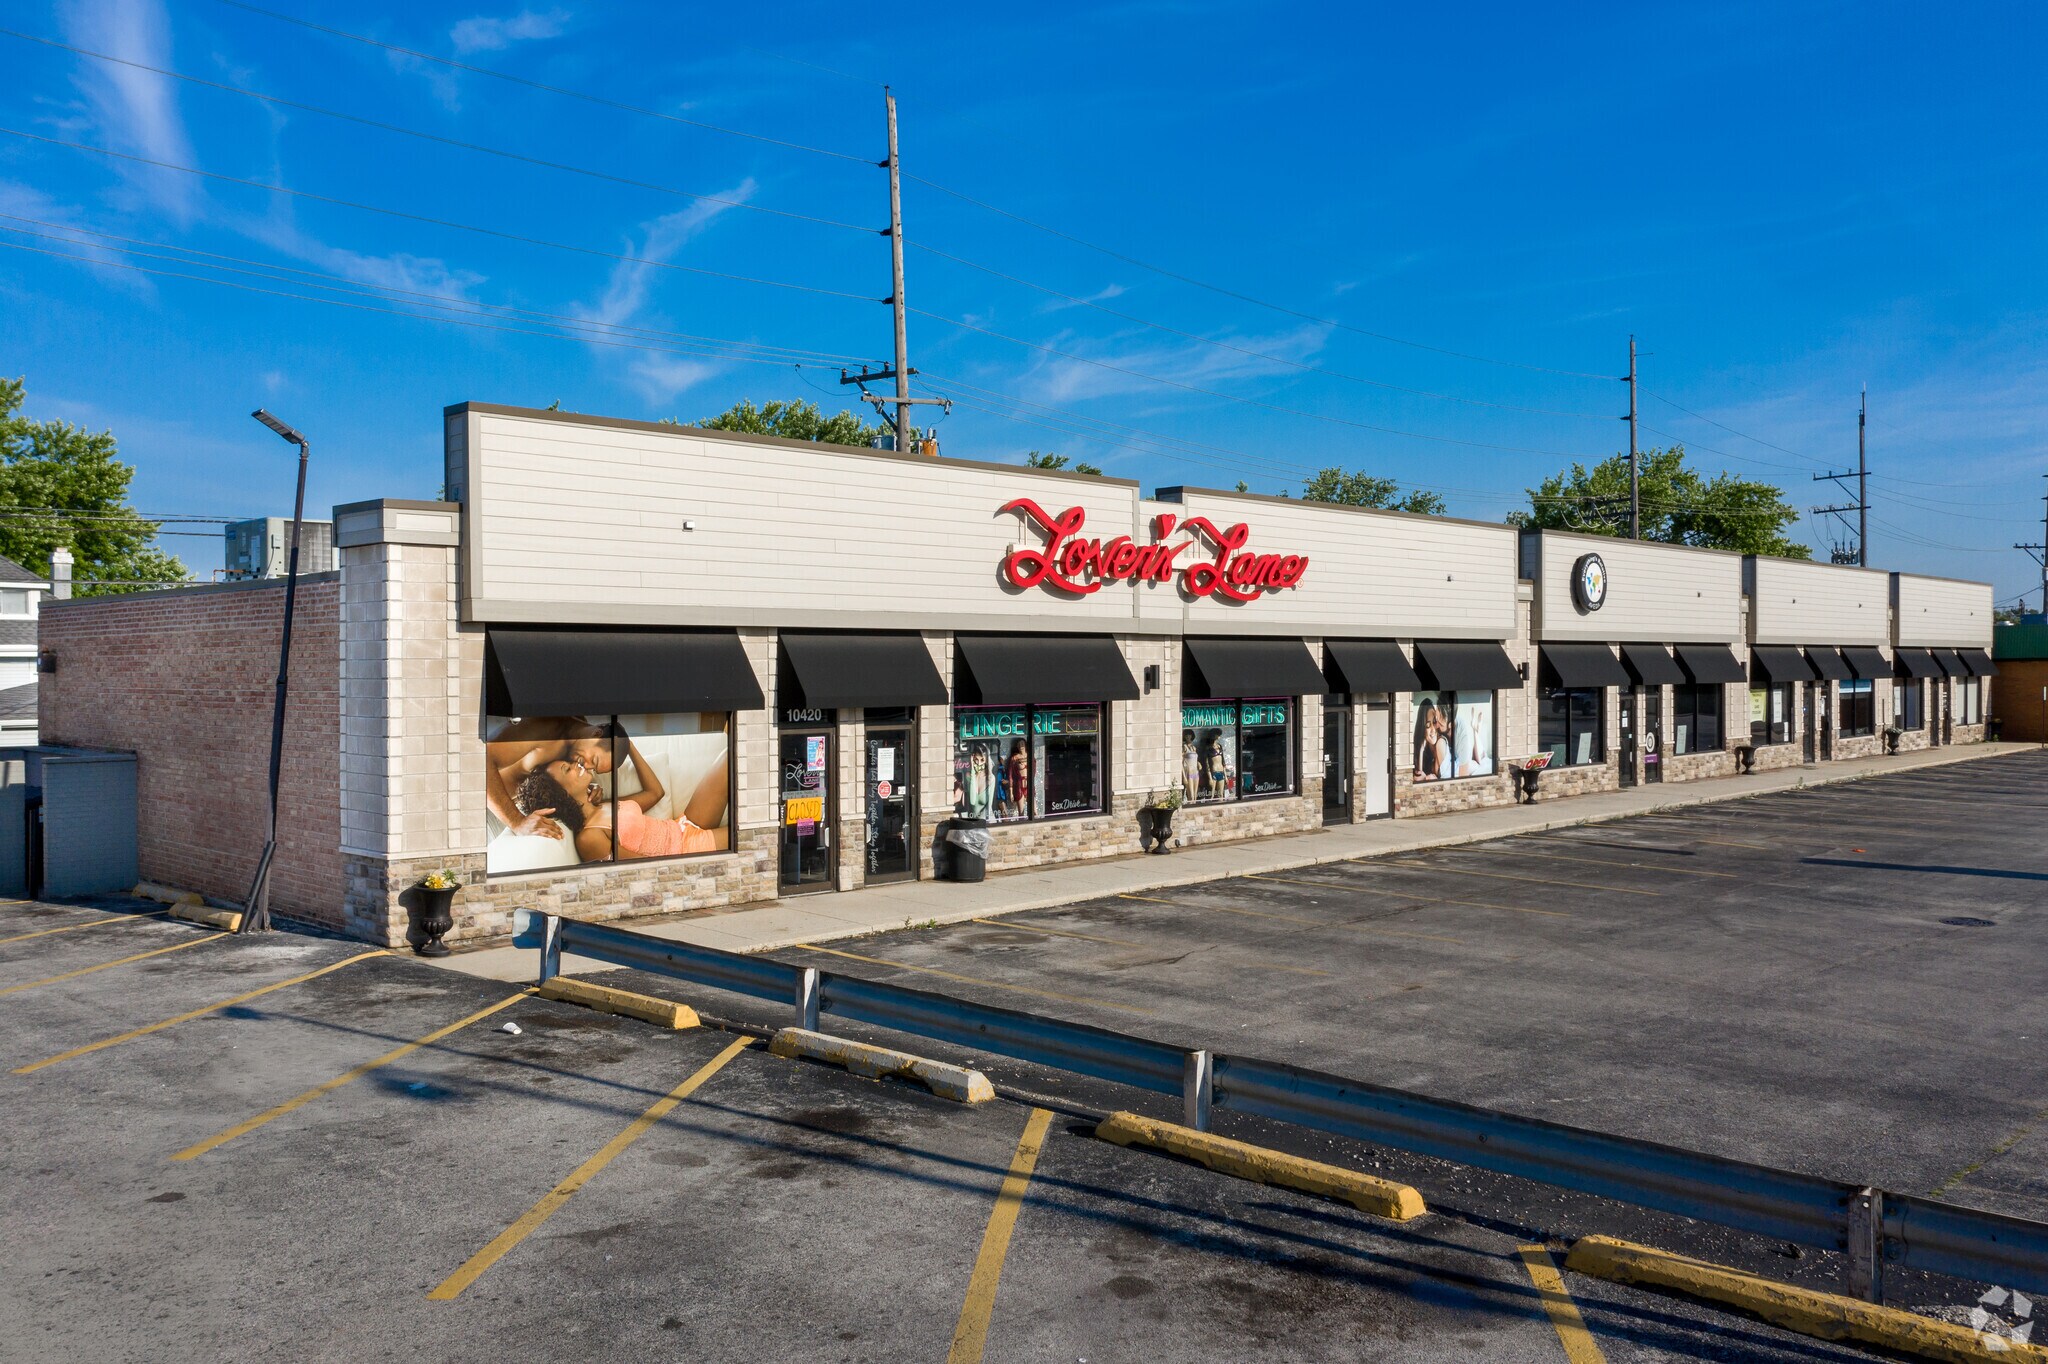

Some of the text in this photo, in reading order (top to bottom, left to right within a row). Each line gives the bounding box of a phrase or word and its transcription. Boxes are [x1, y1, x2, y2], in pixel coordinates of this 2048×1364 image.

[1182, 516, 1309, 601] Lane
[787, 709, 822, 722] 10420
[960, 711, 1062, 738] LINGERIE
[1181, 704, 1285, 727] ROMANTIC GIFTS
[1526, 757, 1550, 769] OPEN
[788, 800, 821, 822] CLOSED
